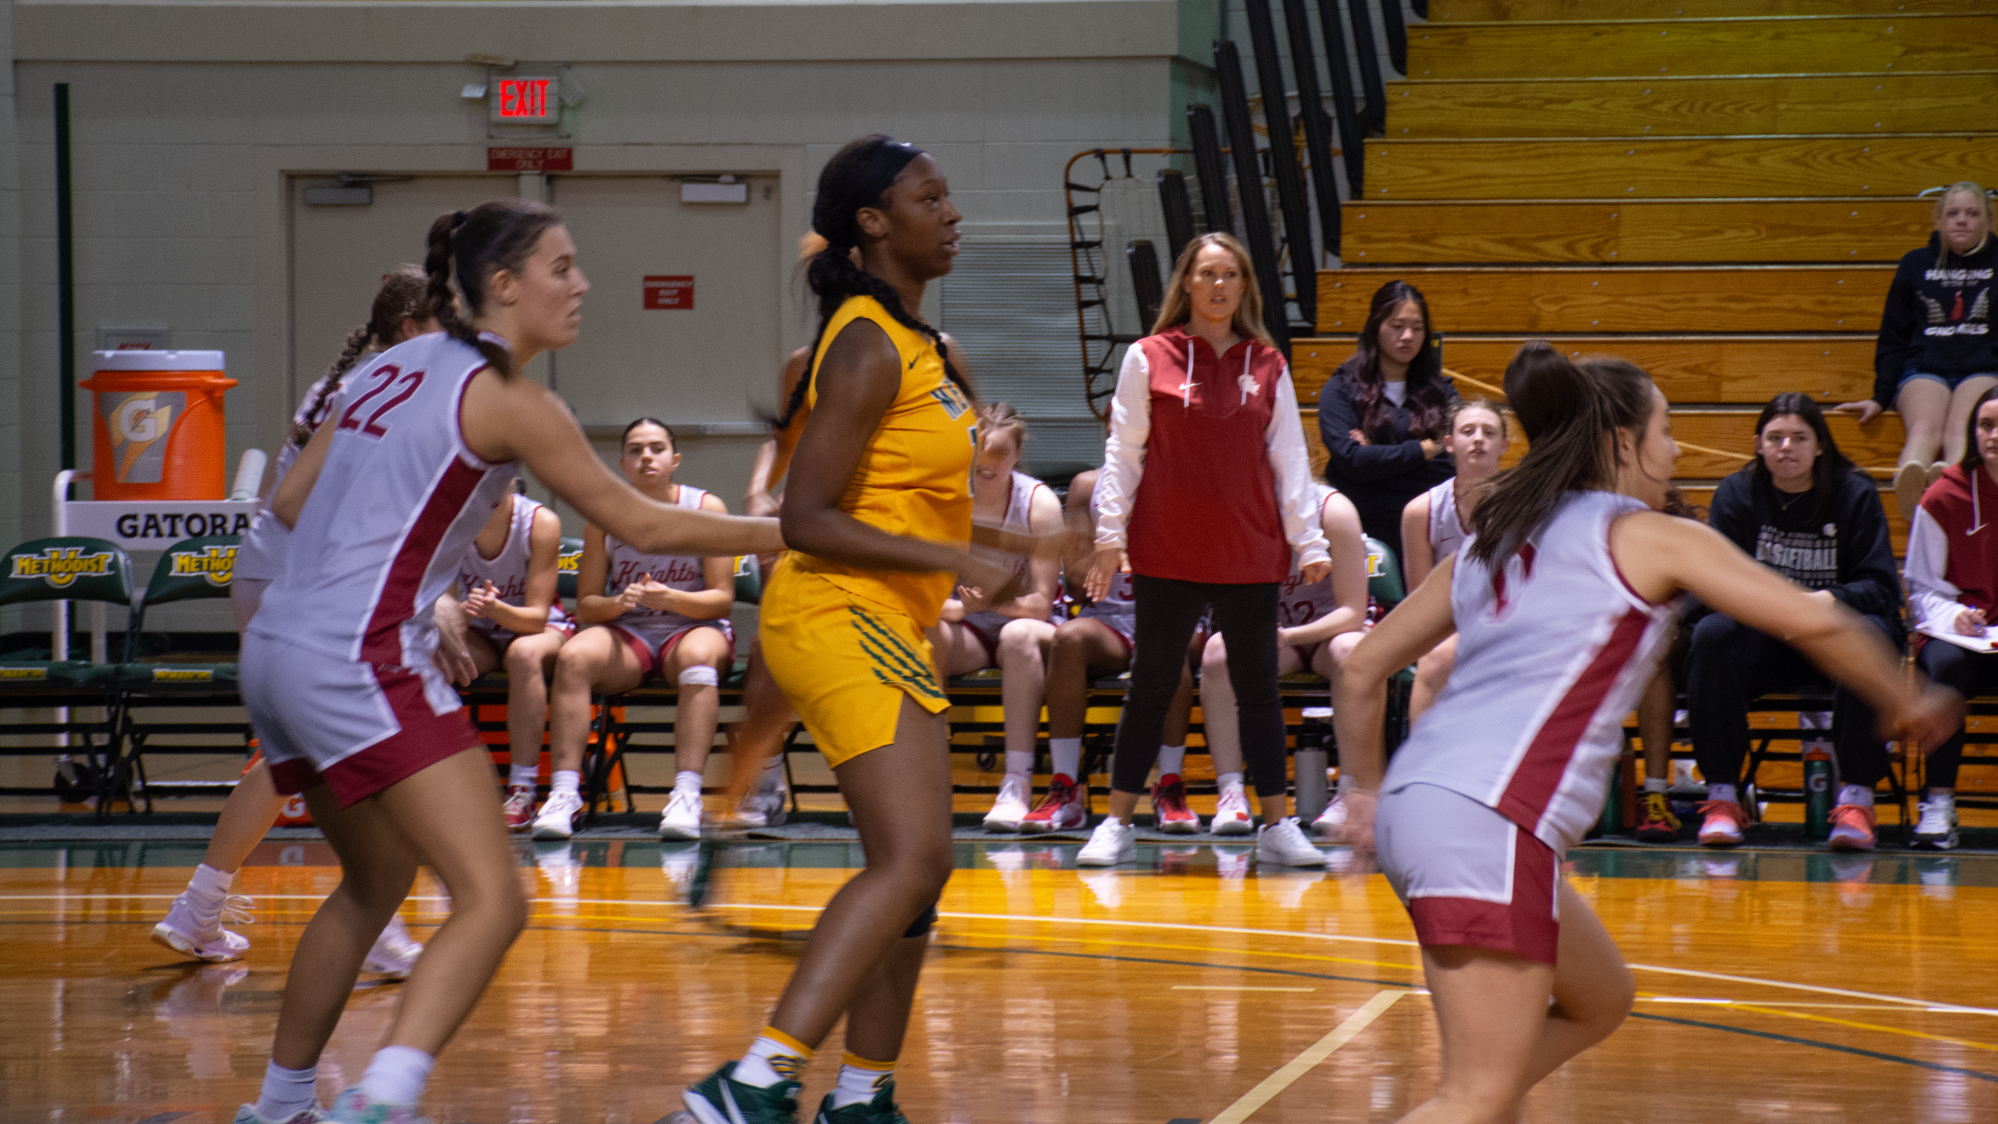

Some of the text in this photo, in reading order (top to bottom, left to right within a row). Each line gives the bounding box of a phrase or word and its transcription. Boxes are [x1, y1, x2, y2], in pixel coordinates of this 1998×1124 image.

[500, 80, 549, 117] EXIT
[339, 363, 427, 440] 22
[117, 513, 249, 538] GATORA
[13, 553, 112, 576] METHODIST
[175, 552, 236, 576] METHO
